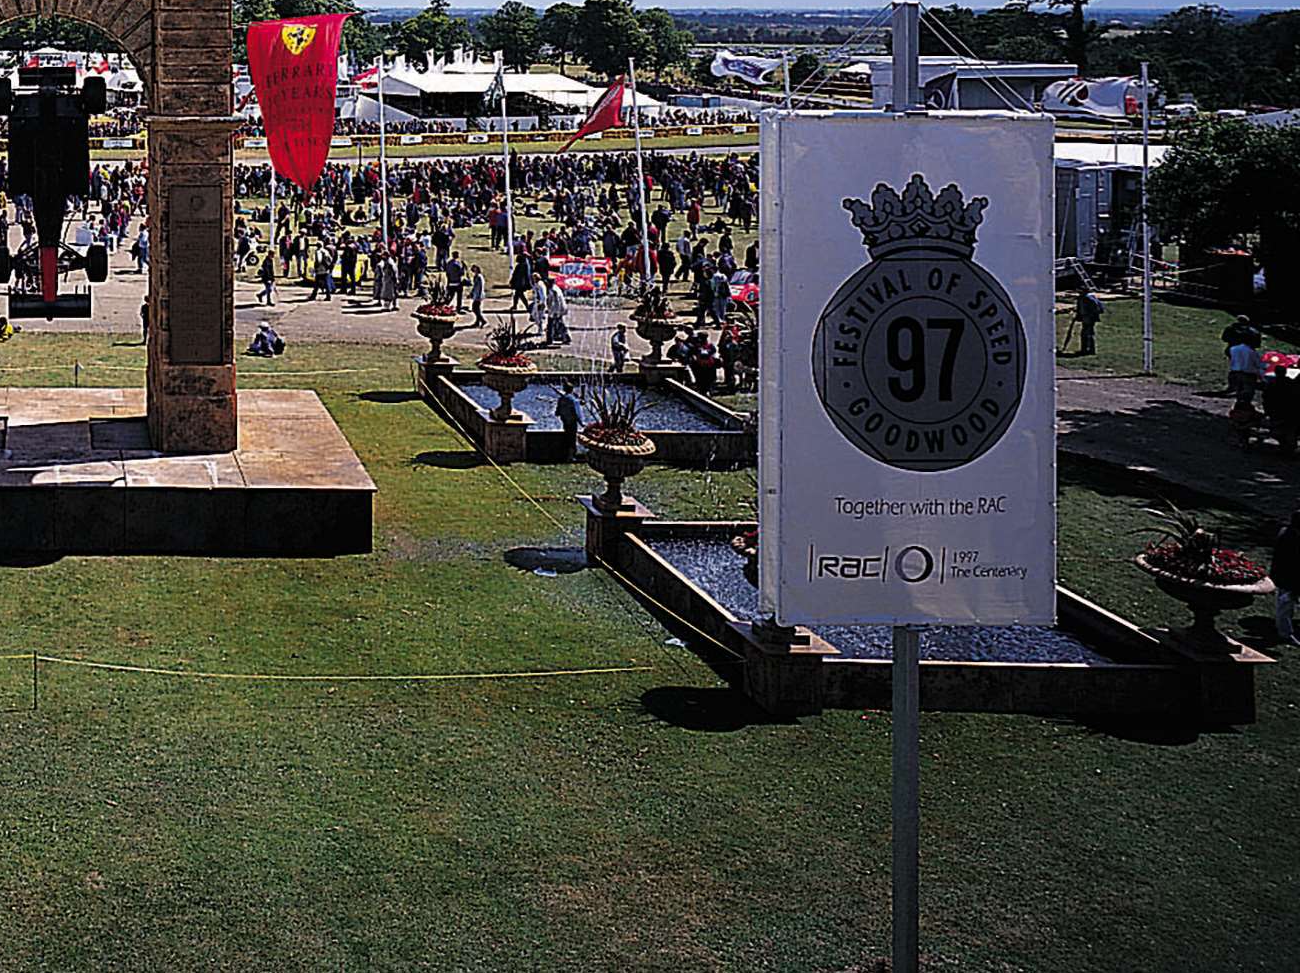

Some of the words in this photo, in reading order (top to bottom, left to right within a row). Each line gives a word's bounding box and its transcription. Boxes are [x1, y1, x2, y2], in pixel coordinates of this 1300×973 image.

[266, 62, 334, 88] FERRARI
[832, 268, 911, 367] FESTIVAL
[928, 268, 960, 295] OF
[969, 290, 1012, 366] SPEED
[886, 315, 966, 402] 97
[848, 396, 1001, 453] GOODWOOD
[835, 496, 906, 518] Together
[909, 497, 945, 515] with
[949, 498, 974, 515] the
[977, 497, 1006, 515] RAC
[952, 551, 979, 563] 1997
[951, 565, 971, 577] The
[973, 565, 1028, 580] Centenary
